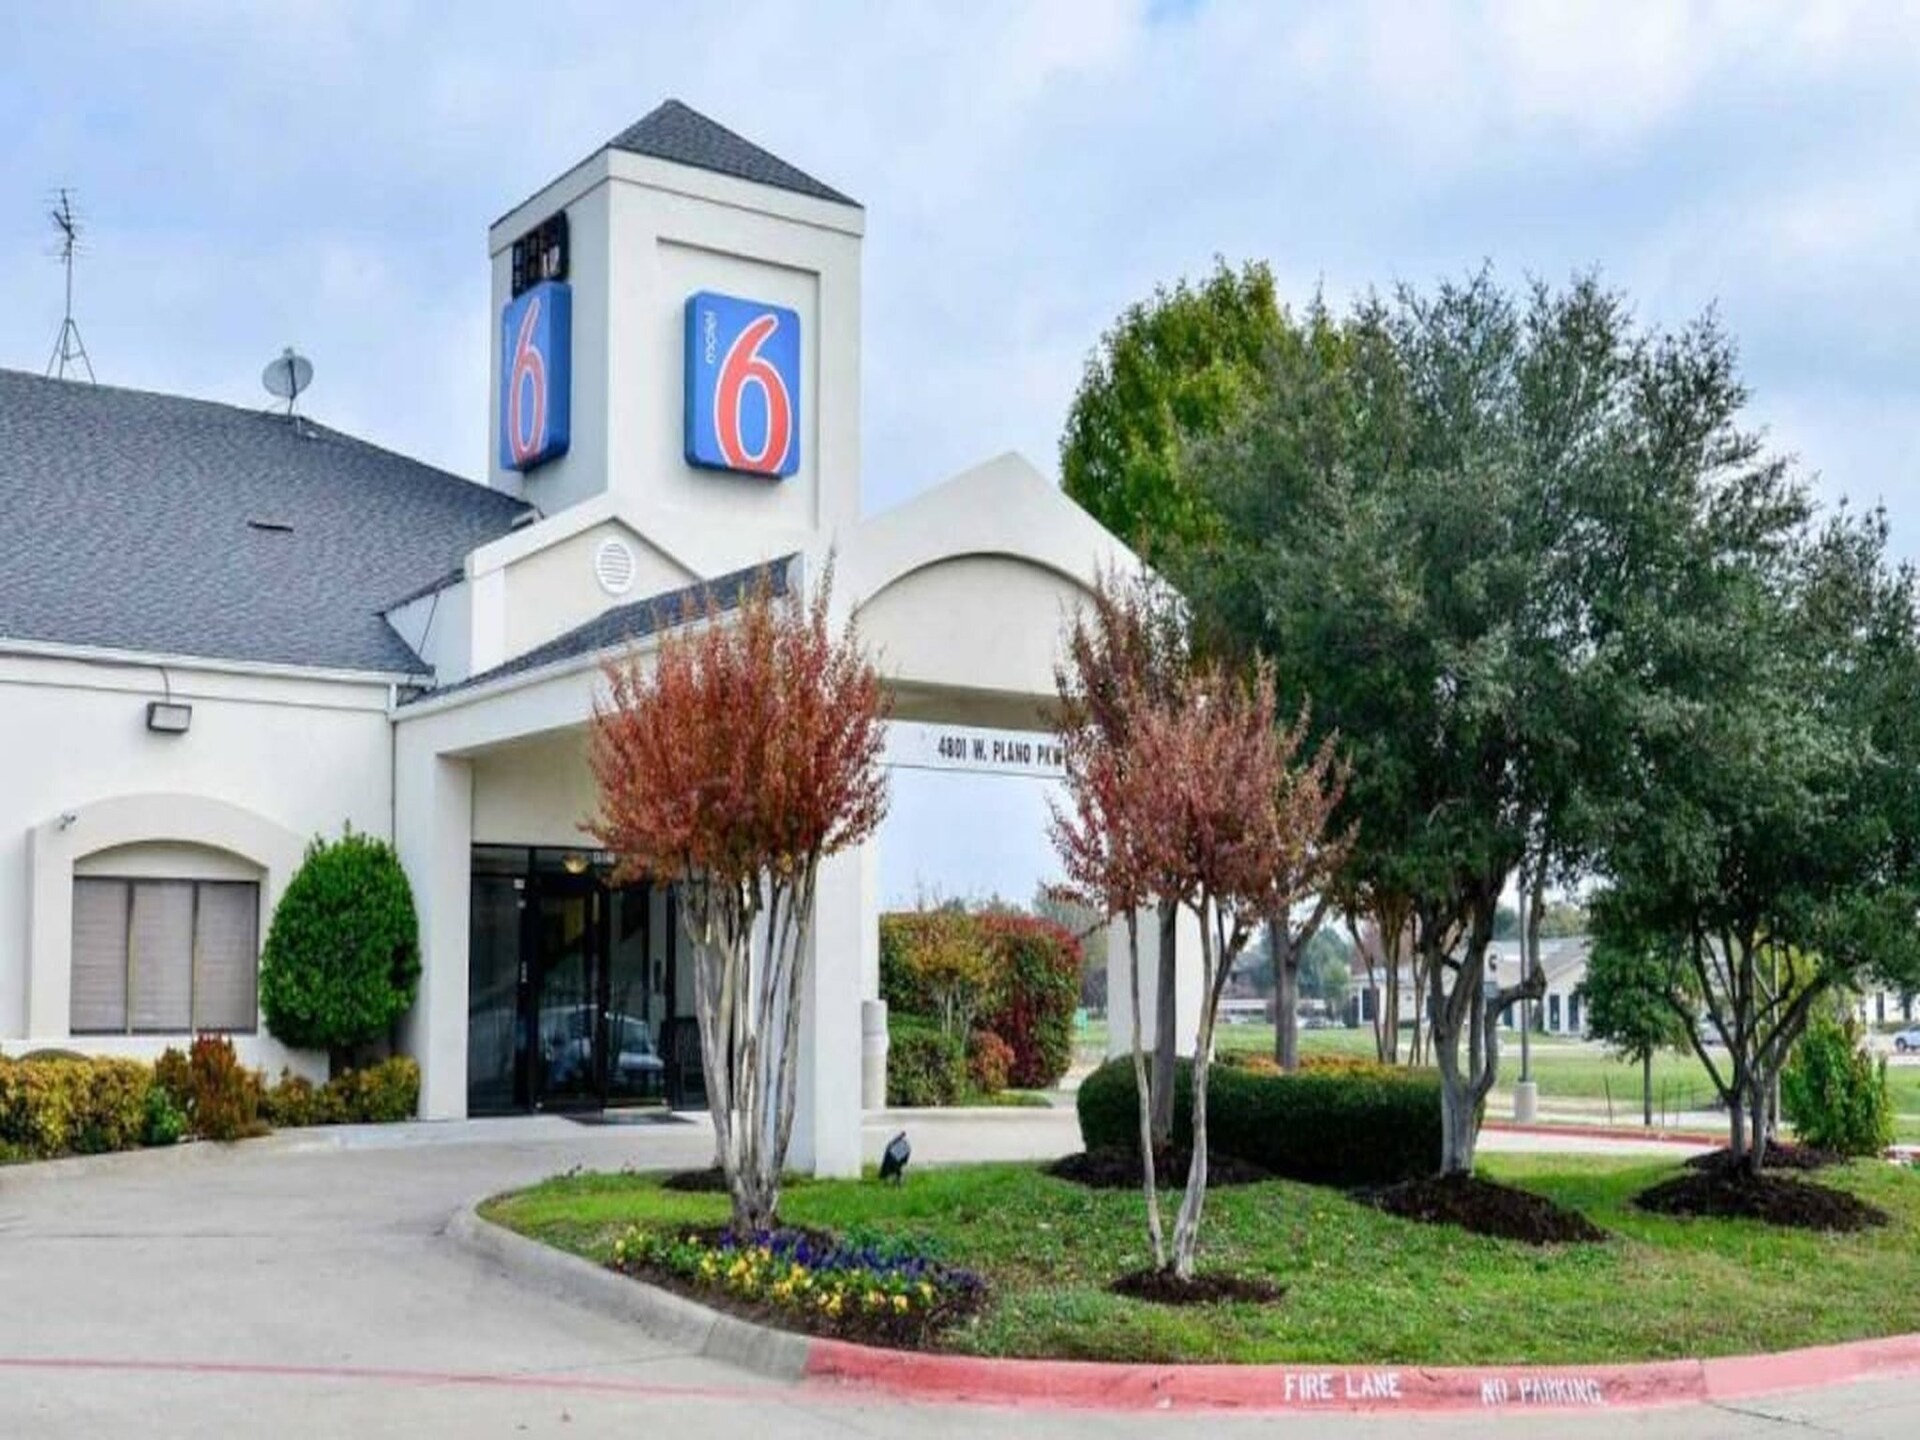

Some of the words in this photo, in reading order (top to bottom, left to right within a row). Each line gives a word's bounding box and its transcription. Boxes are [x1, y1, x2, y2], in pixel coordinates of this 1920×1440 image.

[509, 297, 547, 465] 6
[714, 313, 793, 471] 6
[938, 735, 967, 761] 4801
[973, 739, 987, 762] W.
[993, 740, 1031, 764] PLANO
[1284, 1373, 1334, 1401] FIRE
[1345, 1373, 1402, 1399] LANE
[1480, 1379, 1510, 1405] NO
[1520, 1379, 1603, 1406] PARKING
